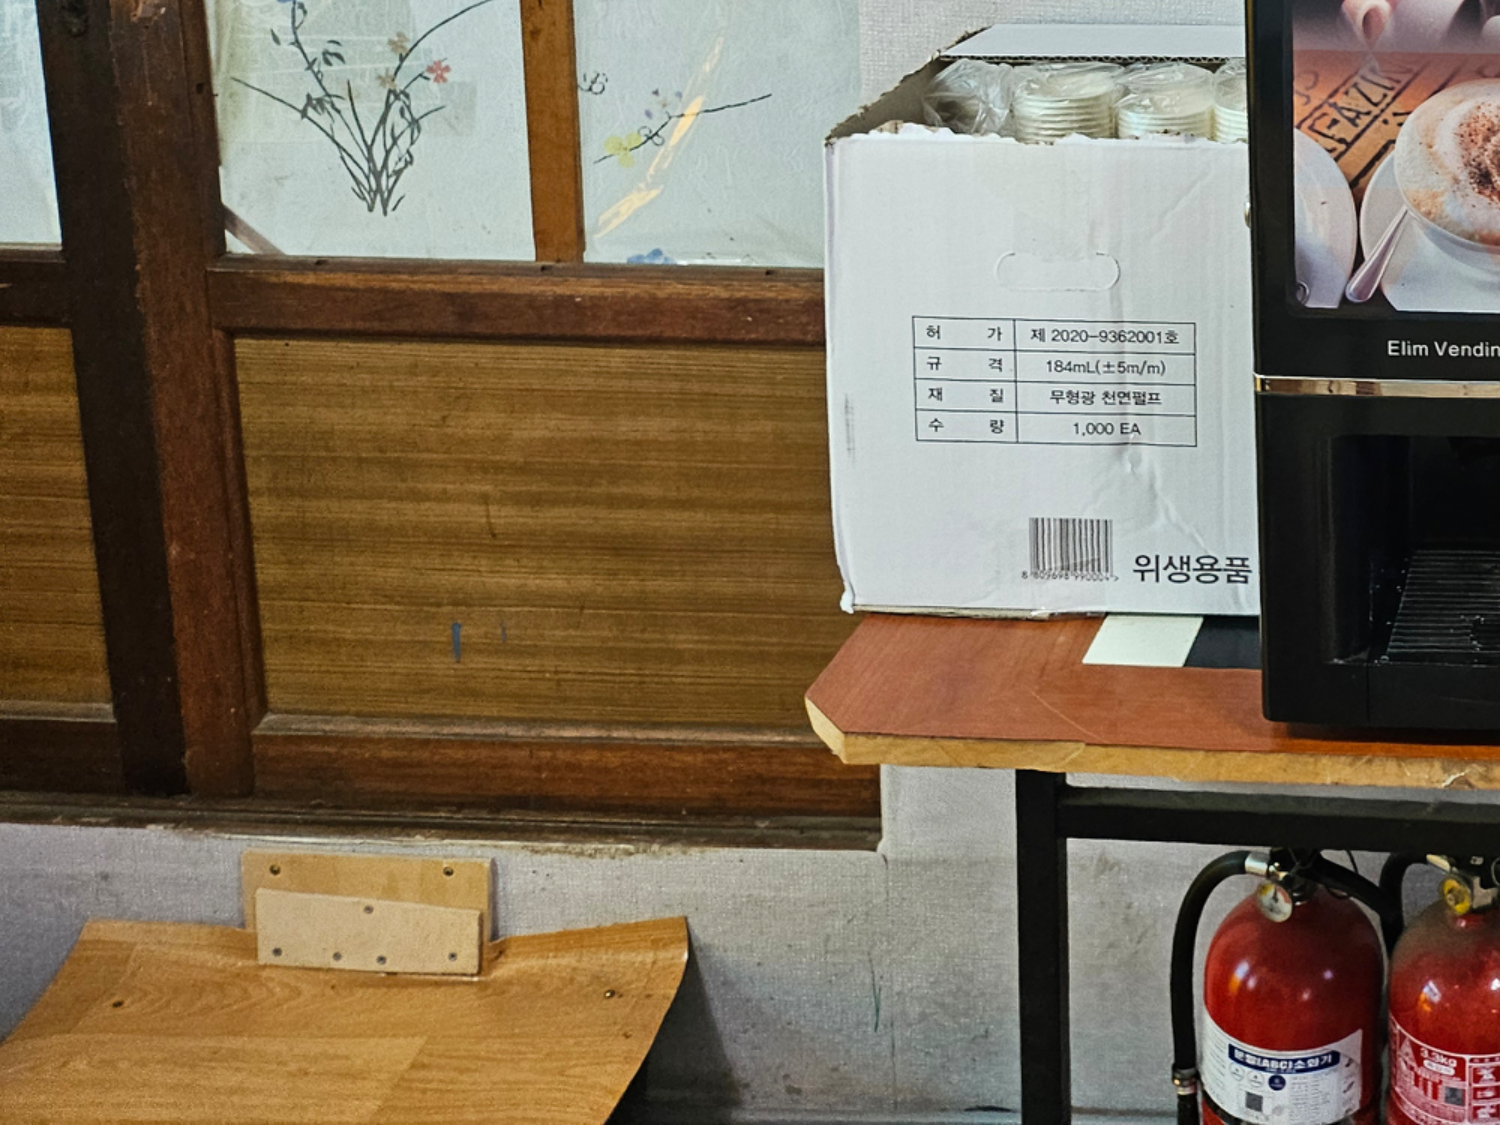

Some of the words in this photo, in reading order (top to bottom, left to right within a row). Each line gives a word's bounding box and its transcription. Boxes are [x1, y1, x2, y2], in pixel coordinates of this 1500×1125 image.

[926, 325, 941, 340] 허
[987, 326, 1003, 341] 가
[1030, 328, 1047, 343] 제
[1051, 329, 1180, 344] 2020-9362001호
[1387, 339, 1429, 357] Elim
[926, 356, 942, 371] 규
[988, 358, 1003, 373] 격
[927, 387, 943, 402] 재
[989, 388, 1004, 403] 질
[1050, 389, 1096, 406] 무형광
[1101, 390, 1163, 406] 천연펄프
[928, 418, 945, 433] 수
[989, 419, 1005, 434] 량
[1073, 422, 1115, 437] 1,000
[1120, 423, 1142, 435] EA
[1132, 554, 1253, 584] 위생용품
